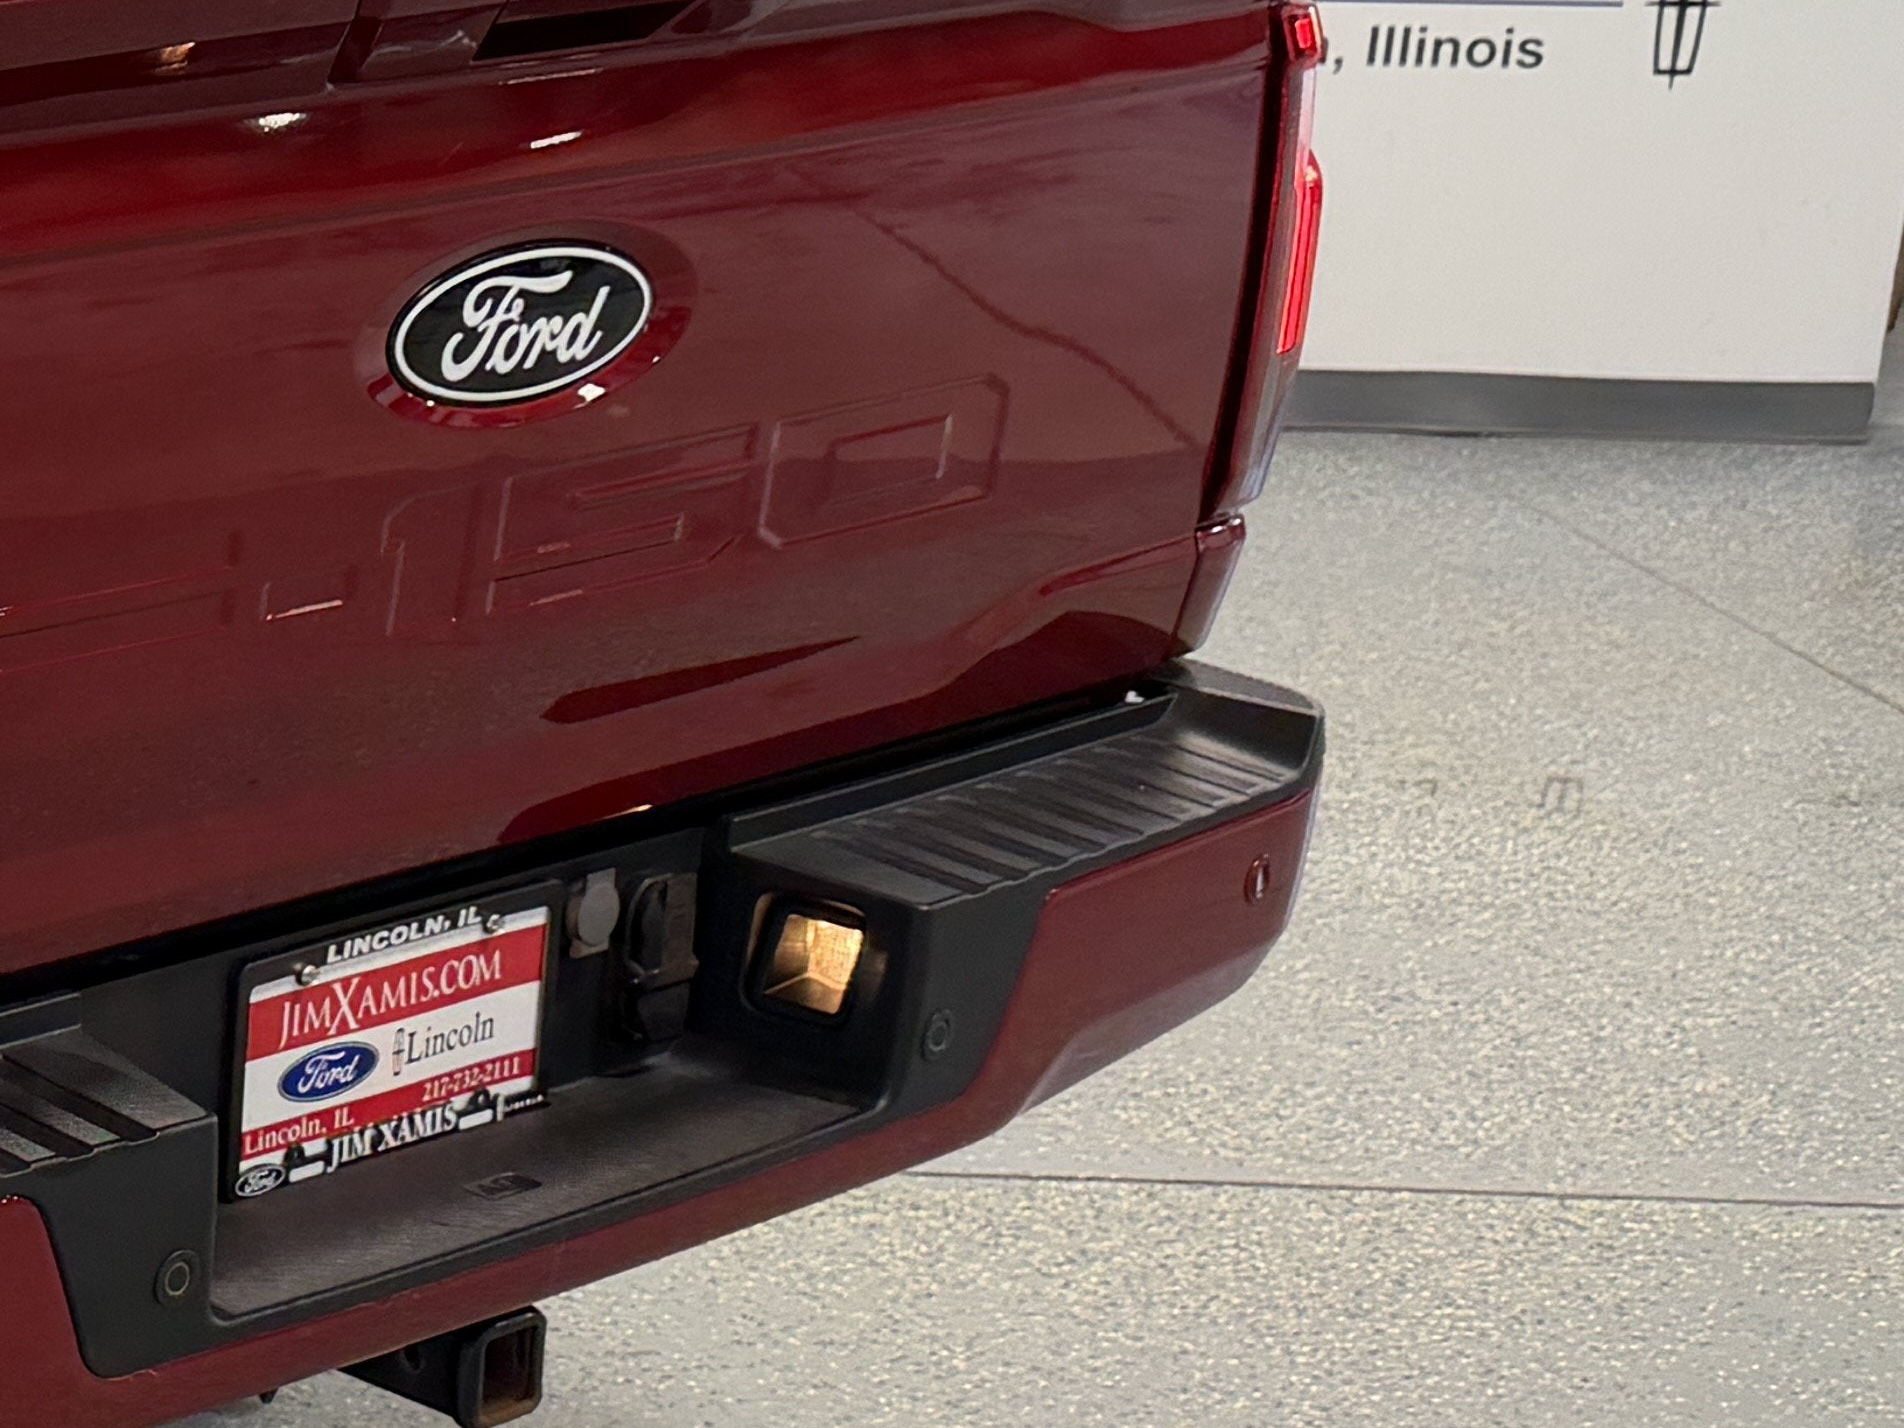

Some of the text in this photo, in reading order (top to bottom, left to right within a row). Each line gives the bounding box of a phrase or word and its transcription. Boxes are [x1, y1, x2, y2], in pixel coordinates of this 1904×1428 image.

[1365, 24, 1545, 70] Illinois
[441, 270, 611, 382] Ford
[326, 906, 482, 964] LINCOLN, IL
[296, 1011, 495, 1093] Ford Lincoln
[326, 1128, 378, 1173] JIM
[379, 1103, 458, 1152] XAMIS
[334, 1107, 355, 1129] IL
